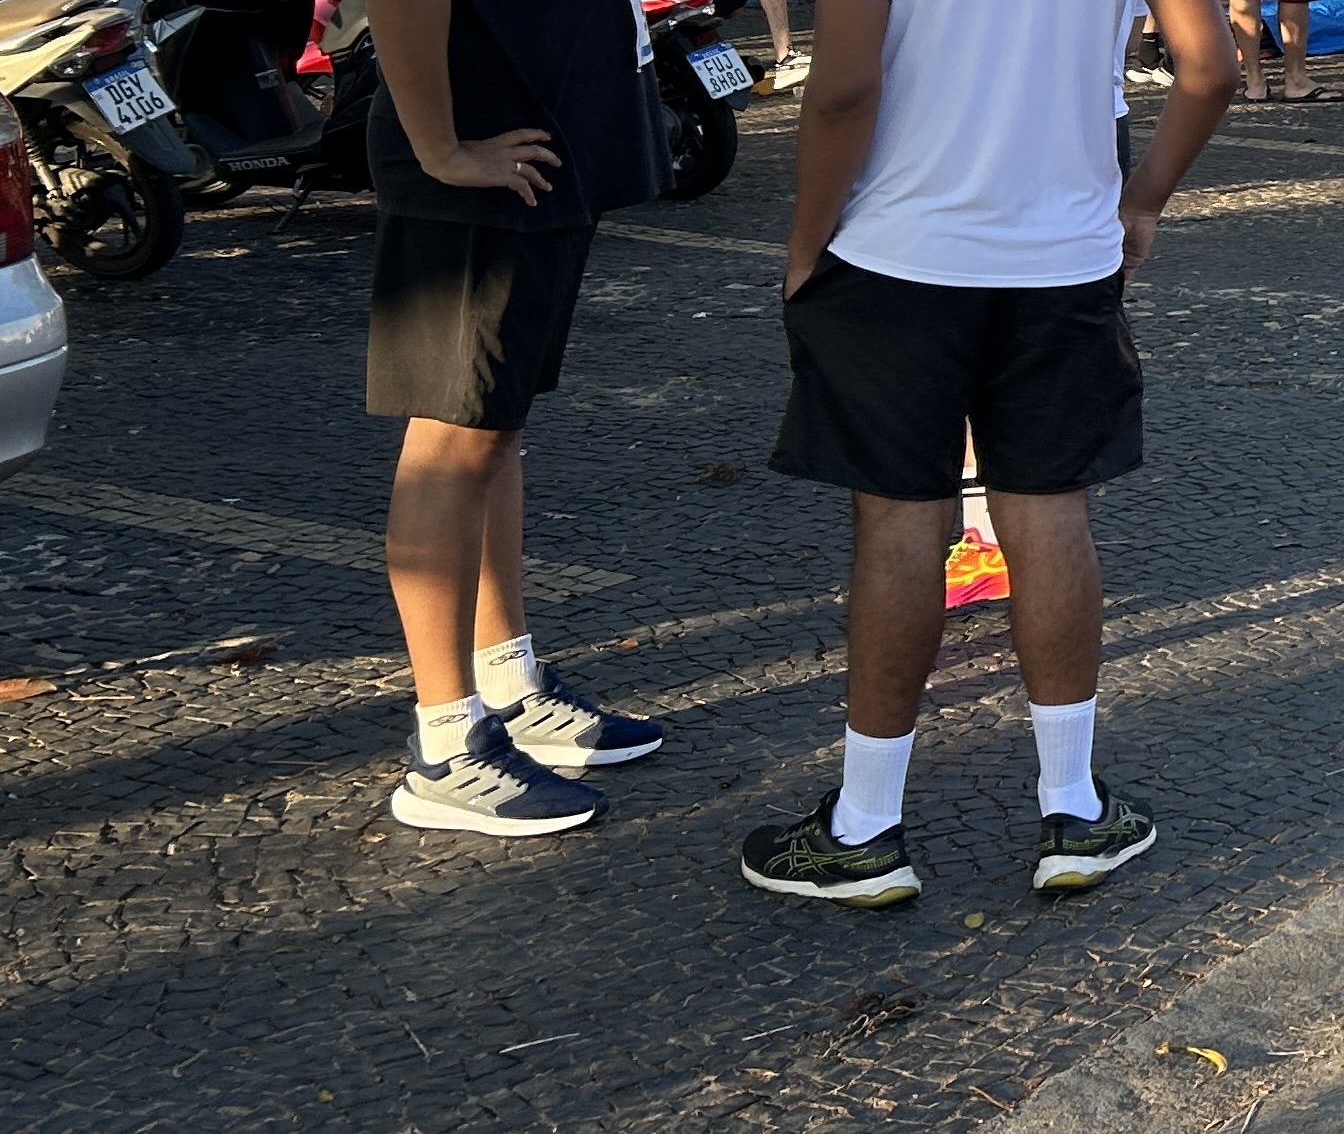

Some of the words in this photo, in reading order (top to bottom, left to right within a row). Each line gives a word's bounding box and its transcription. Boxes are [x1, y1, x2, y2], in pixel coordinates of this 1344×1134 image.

[703, 53, 733, 76] FUJ
[104, 73, 144, 105] DGY
[709, 67, 747, 93] 8H80
[116, 91, 165, 124] 4106
[227, 156, 291, 171] HONDA
